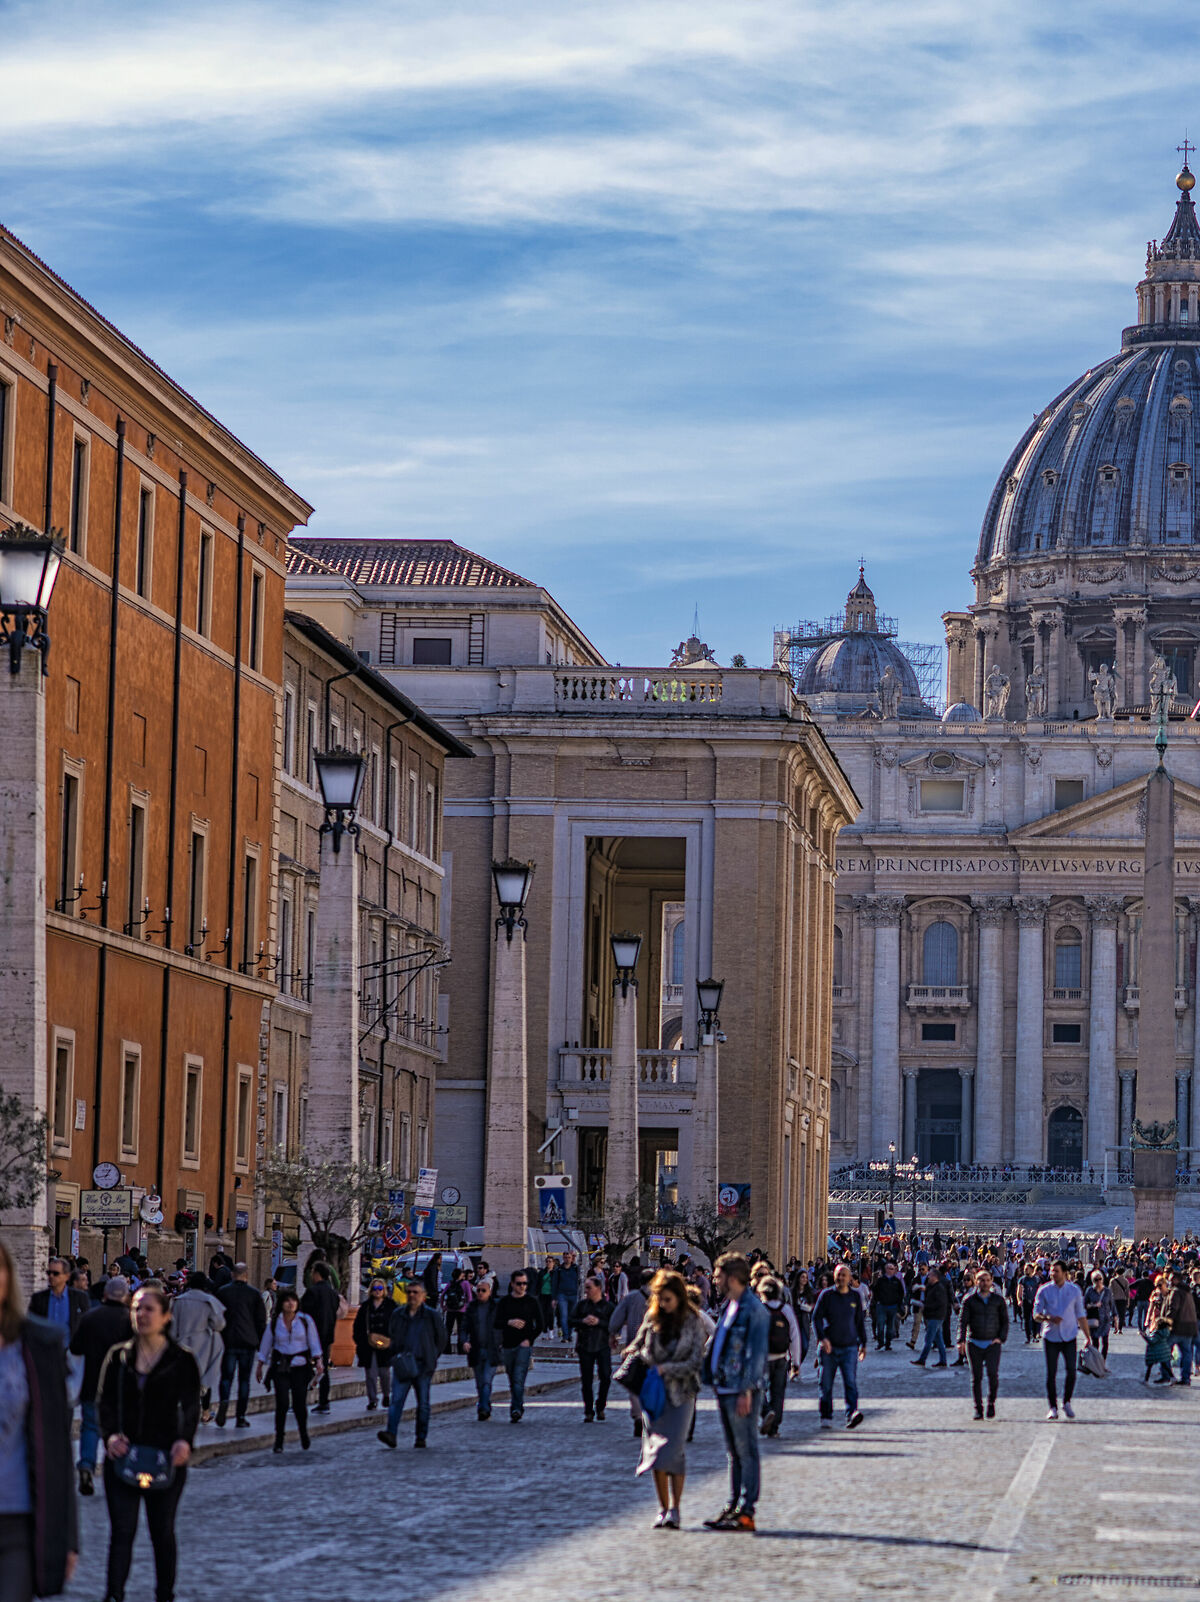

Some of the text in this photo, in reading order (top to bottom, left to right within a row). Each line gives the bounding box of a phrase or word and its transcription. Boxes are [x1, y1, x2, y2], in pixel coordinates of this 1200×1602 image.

[876, 858, 963, 872] PRINCIPIS
[966, 858, 1019, 872] APOST
[1021, 859, 1078, 872] PAVLVS
